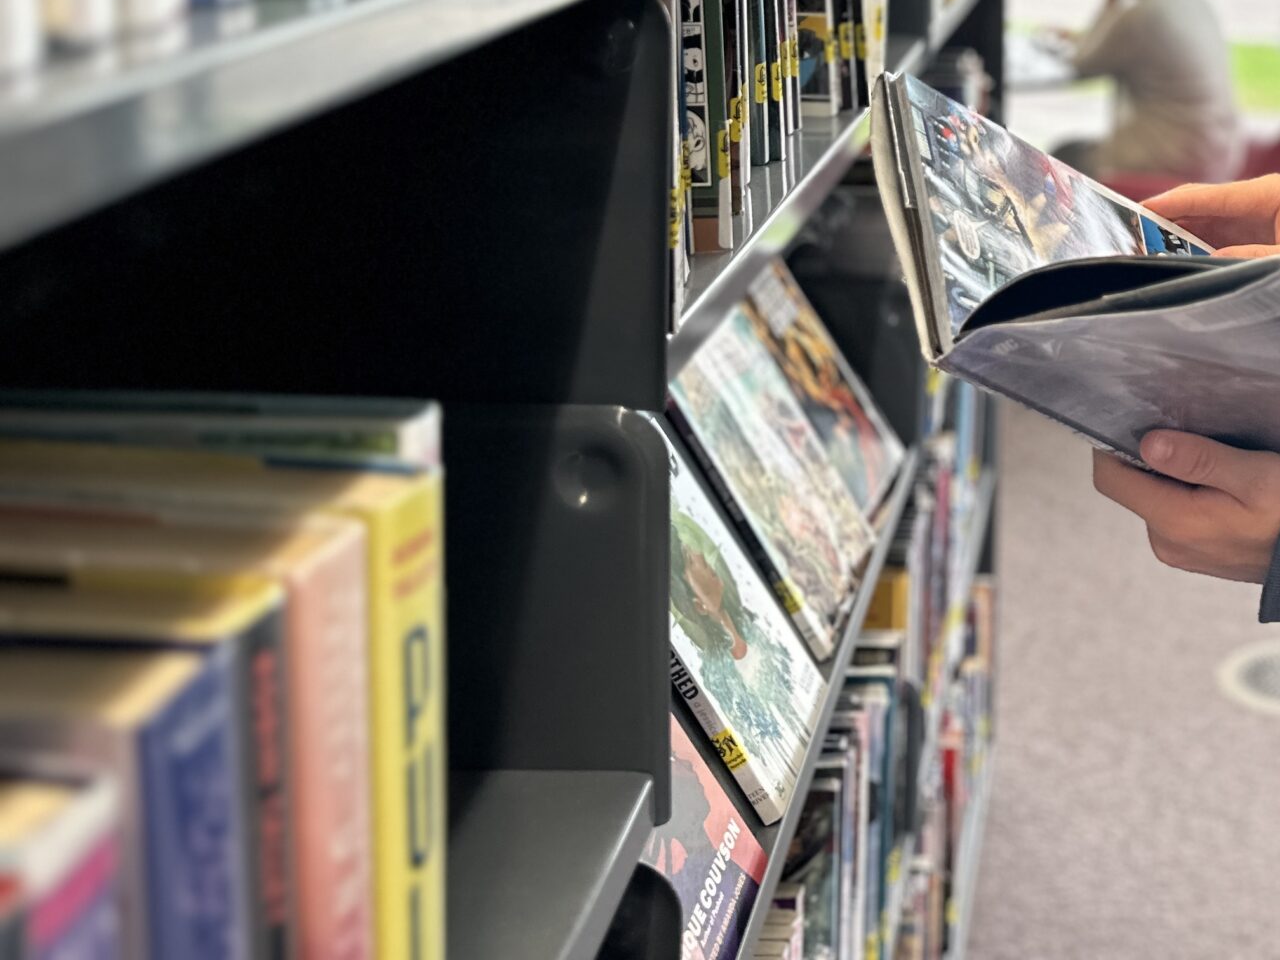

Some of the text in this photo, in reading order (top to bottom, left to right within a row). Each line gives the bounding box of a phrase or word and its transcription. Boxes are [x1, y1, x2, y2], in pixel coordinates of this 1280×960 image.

[670, 650, 699, 701] THED
[700, 818, 740, 909] COUVSON
[735, 872, 746, 900] JONES
